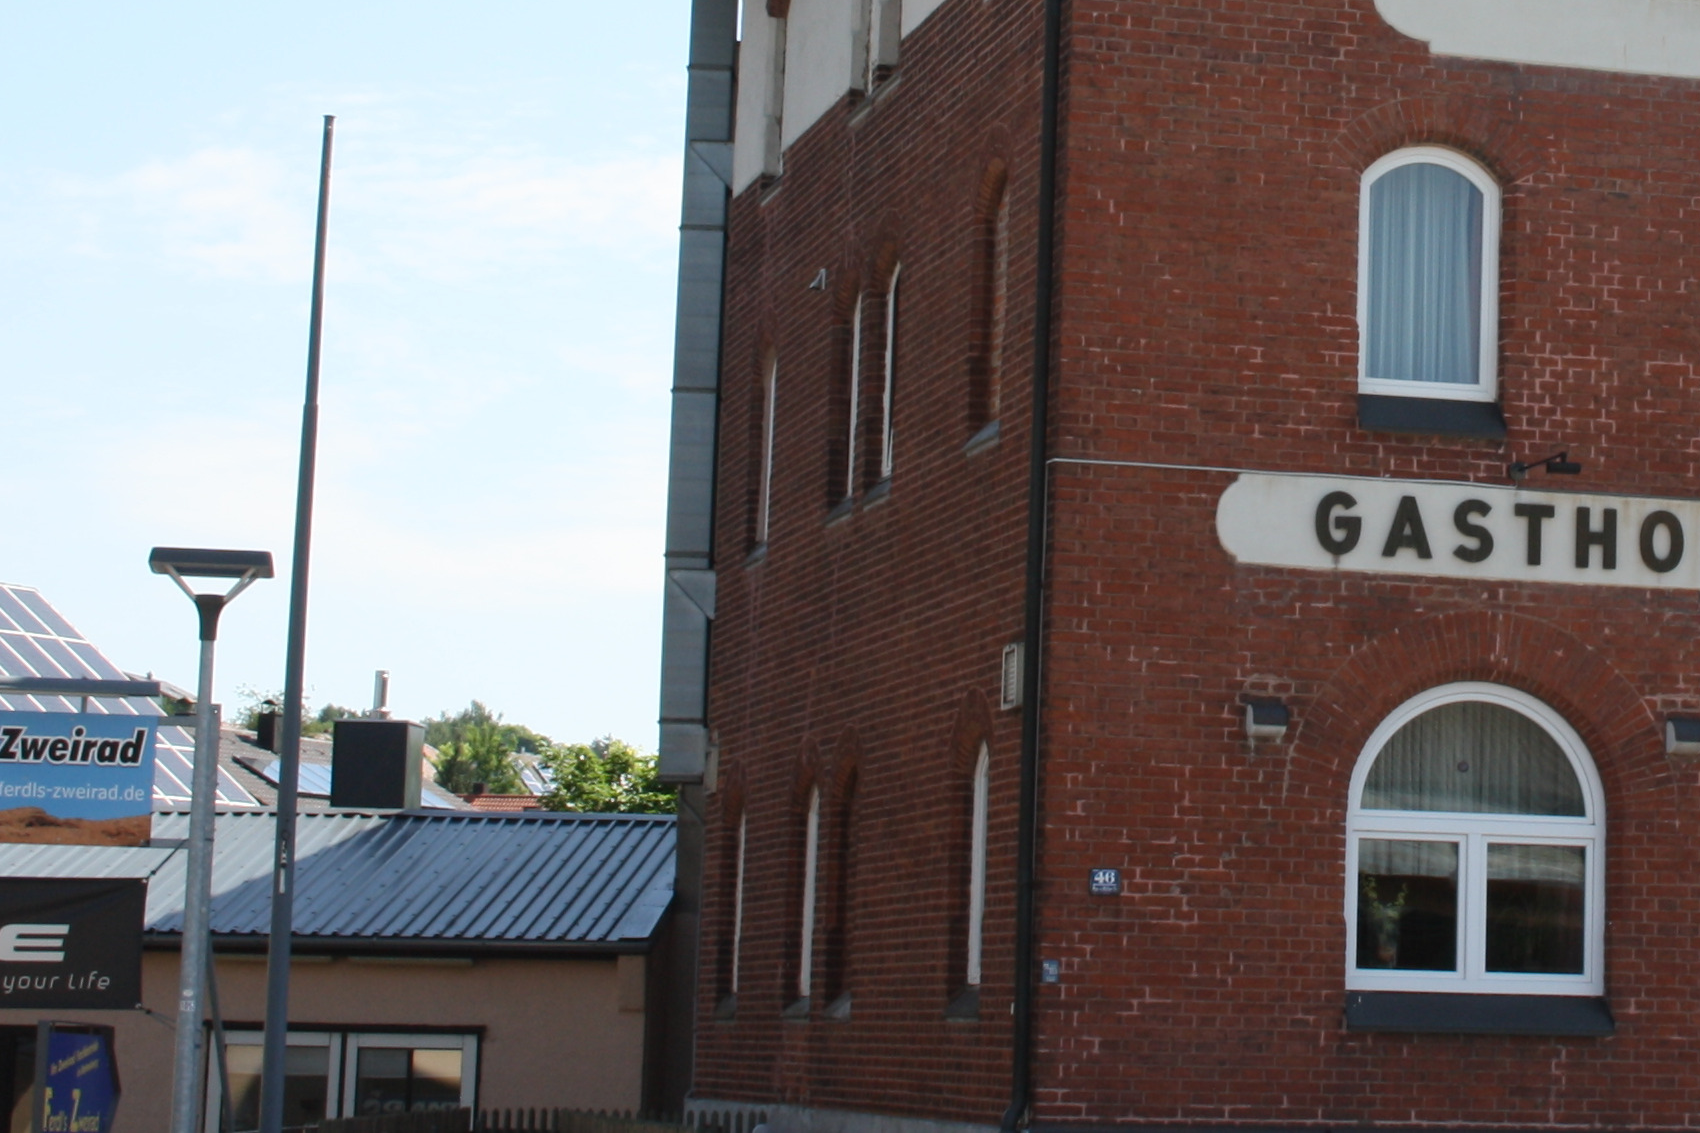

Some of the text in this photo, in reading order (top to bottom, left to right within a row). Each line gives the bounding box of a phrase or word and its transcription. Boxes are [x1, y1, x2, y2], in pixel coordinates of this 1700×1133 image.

[0, 726, 148, 767] Zweirad
[1094, 871, 1116, 884] 46
[3, 971, 110, 994] your life
